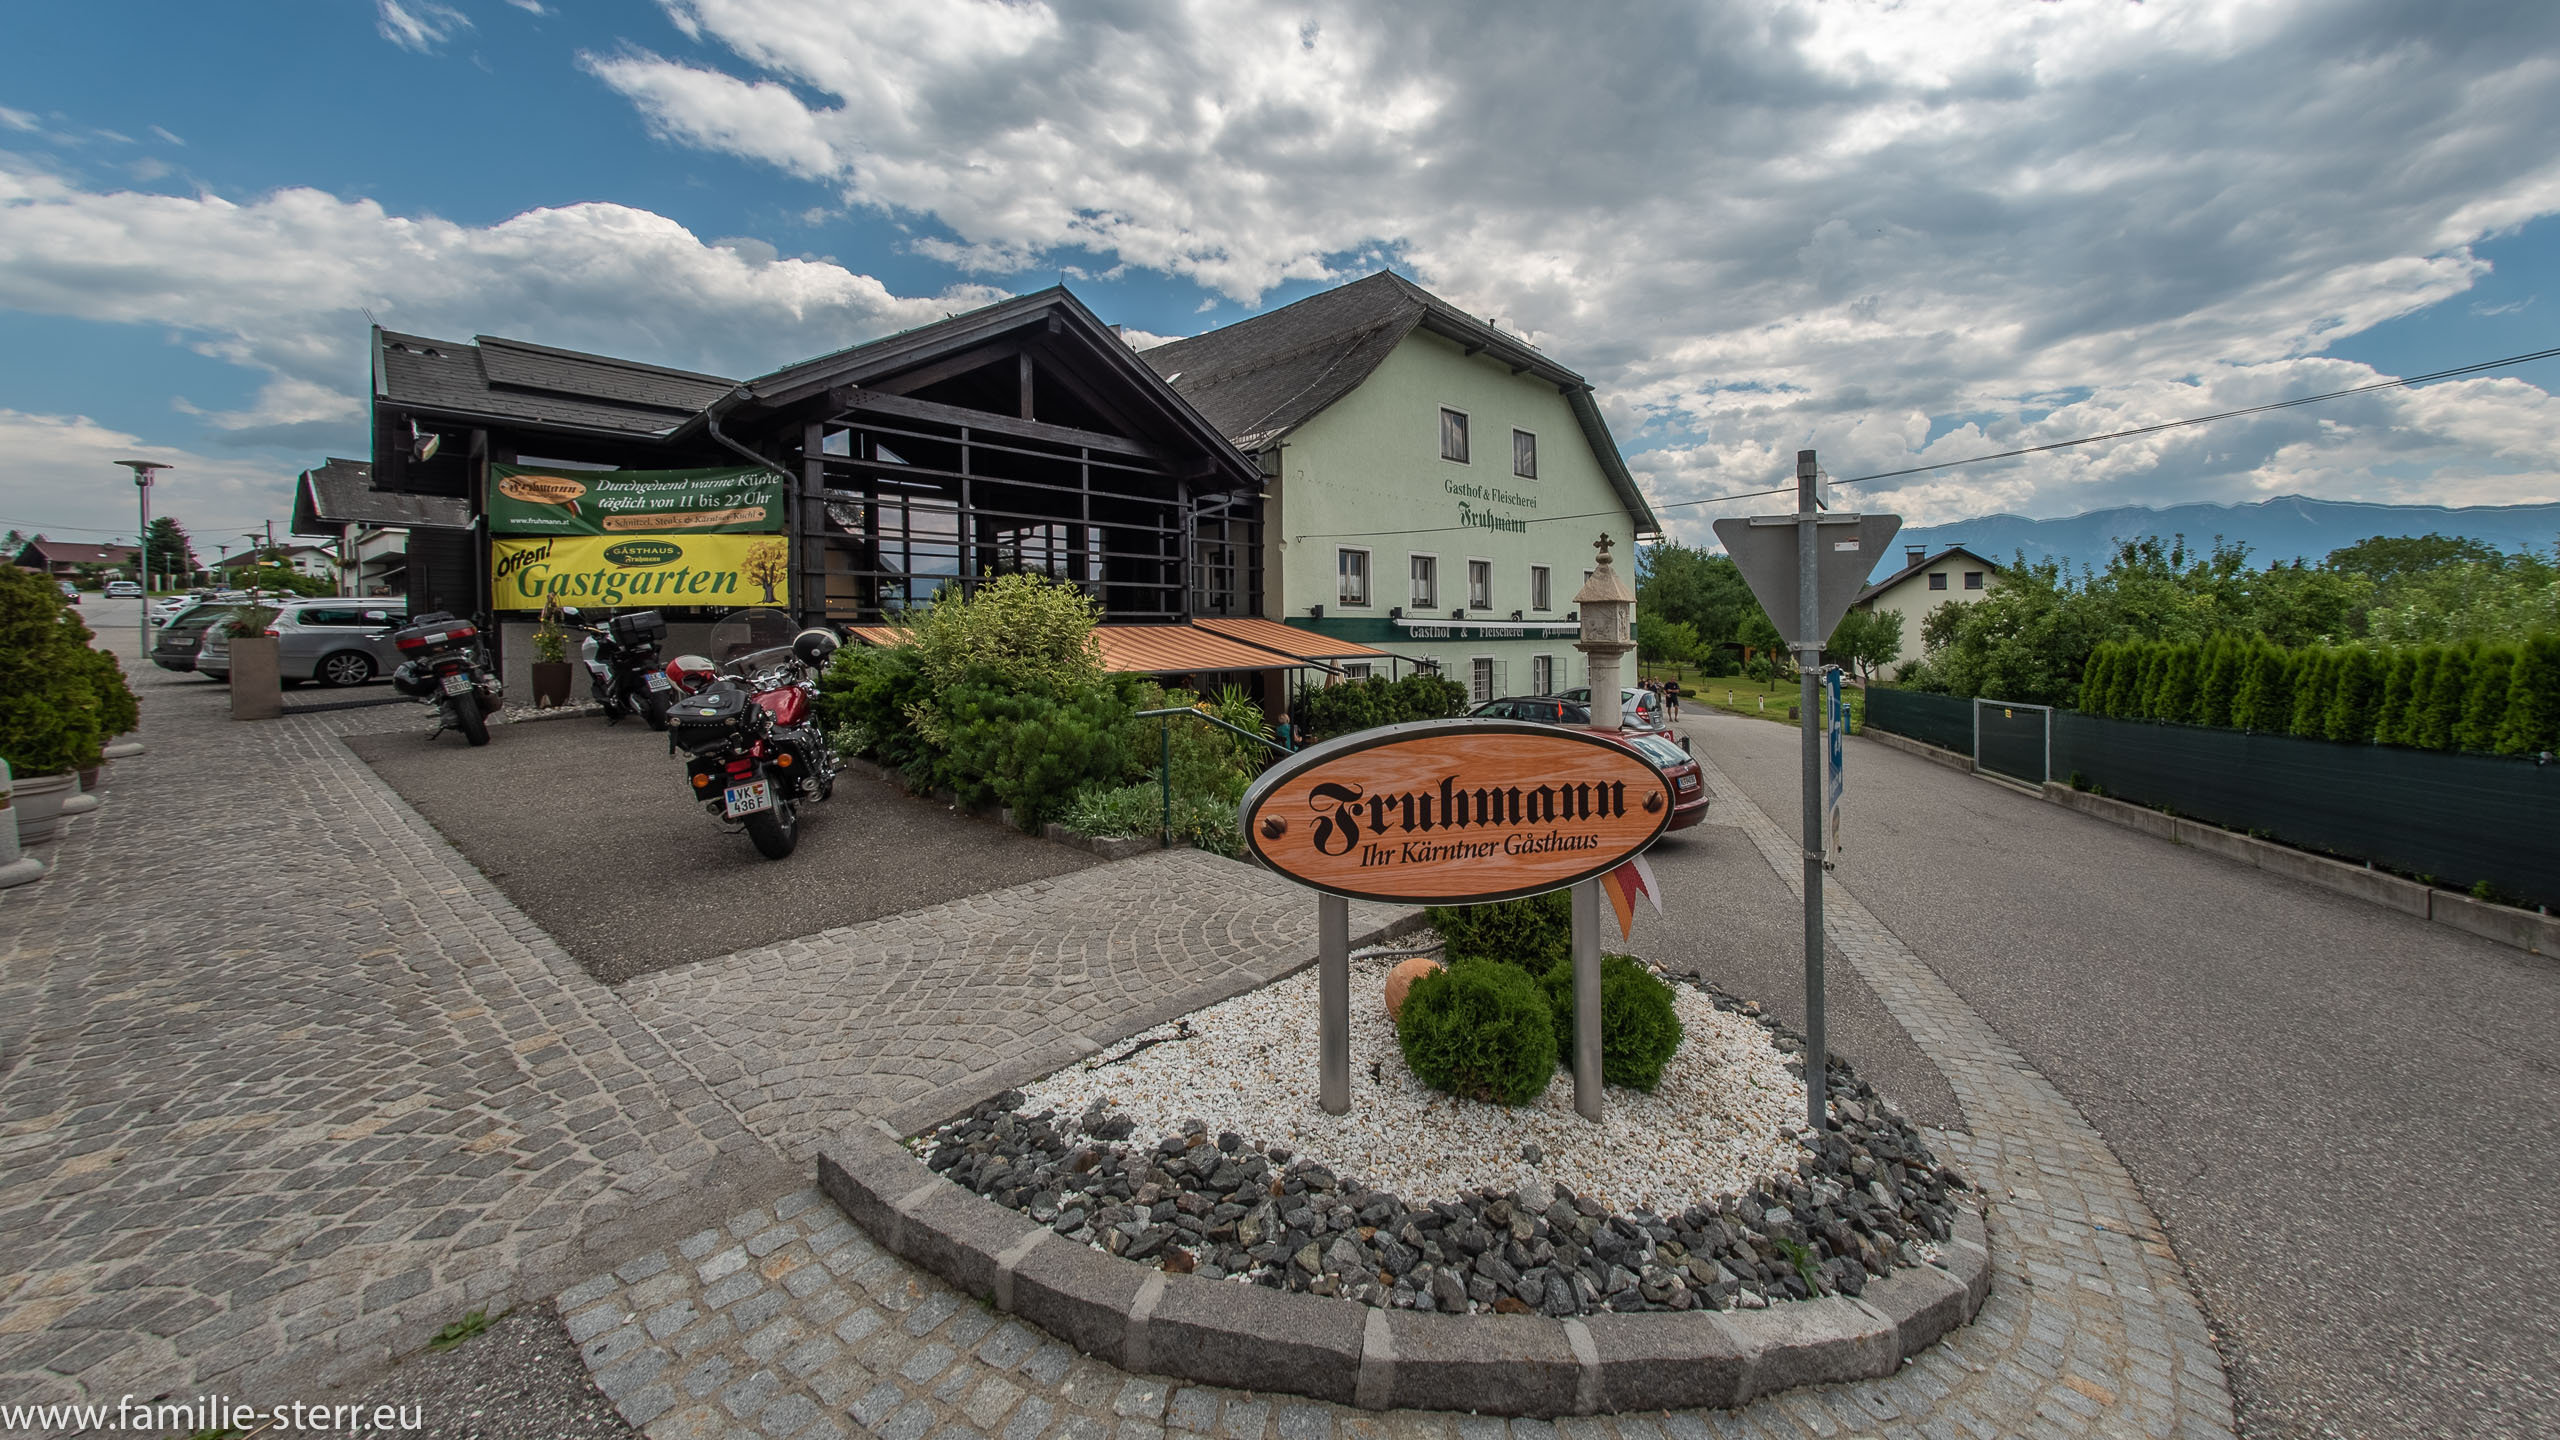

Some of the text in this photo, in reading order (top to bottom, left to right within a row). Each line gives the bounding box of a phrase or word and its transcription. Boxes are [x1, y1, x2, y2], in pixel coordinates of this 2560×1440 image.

[596, 473, 780, 495] Durchgehend warme Küche
[1444, 479, 1537, 508] Gasthof & Fleischerei
[598, 491, 773, 512] täglich von 11 bis 22 Uhr
[655, 517, 682, 526] Steaks
[497, 538, 554, 577] Offen!
[518, 564, 738, 605] Gastgarten
[734, 798, 755, 812] 436
[736, 786, 751, 799] VK
[1308, 774, 1631, 856] Fruhmann
[1359, 844, 1395, 867] Ihr
[1400, 838, 1500, 864] Kärntner
